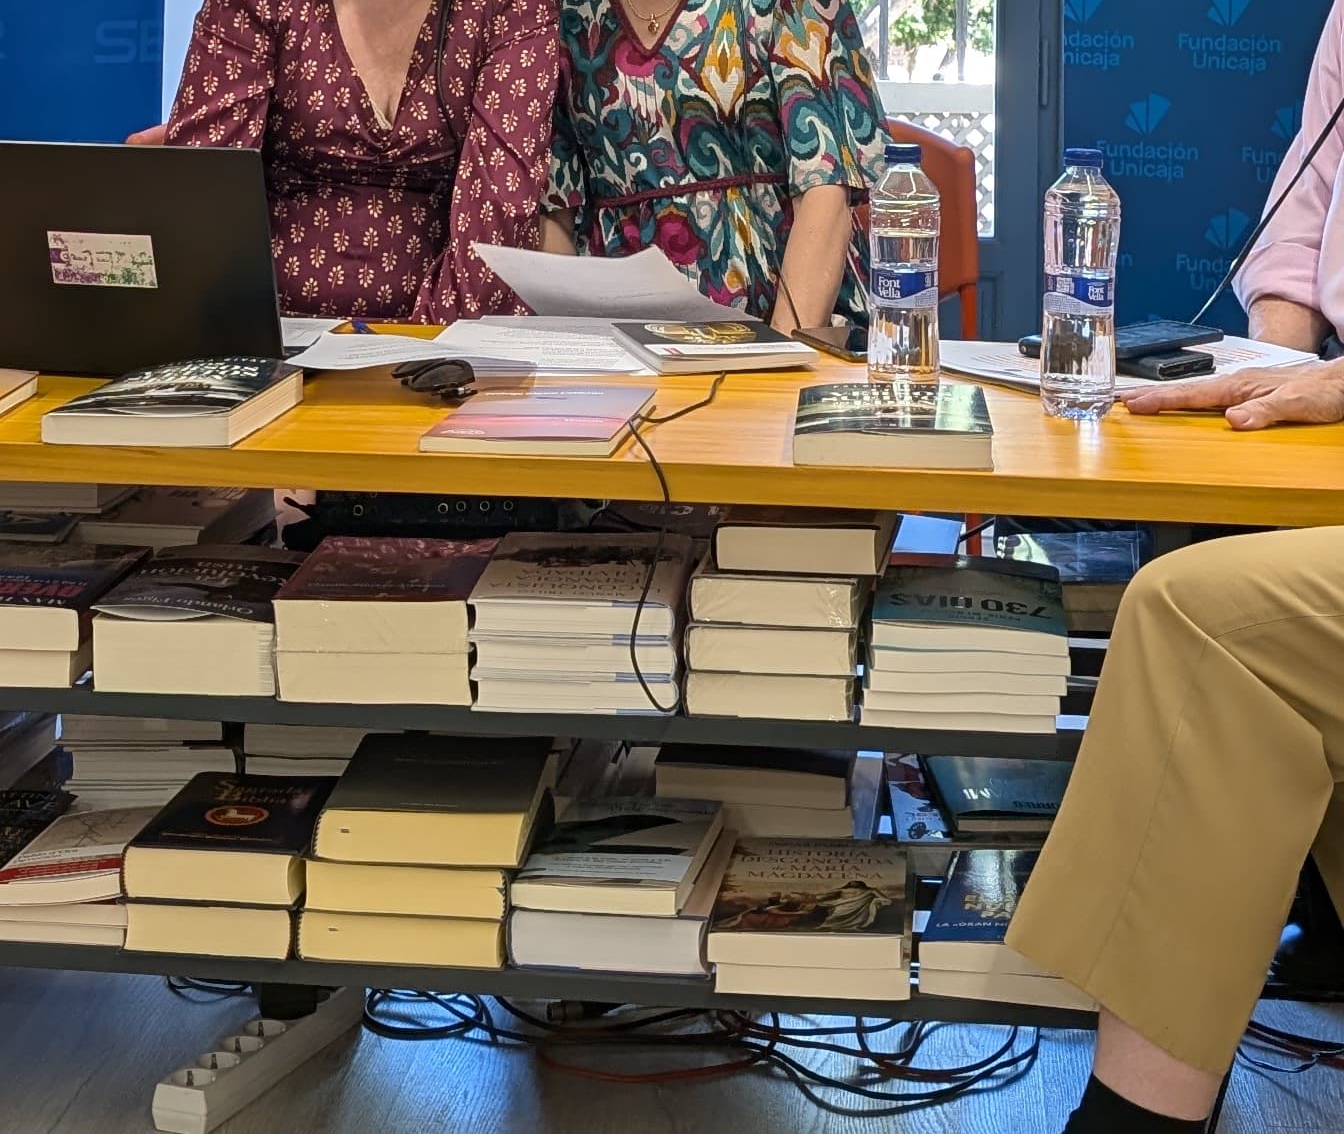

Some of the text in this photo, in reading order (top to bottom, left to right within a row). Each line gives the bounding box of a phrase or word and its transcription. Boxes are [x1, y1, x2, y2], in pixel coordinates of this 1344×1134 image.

[1178, 33, 1281, 53] Fundación
[1192, 52, 1267, 74] Unicaja
[1096, 140, 1199, 161] Fundación
[1110, 160, 1184, 183] Unicaja
[877, 276, 901, 288] Font
[878, 286, 903, 299] Vella
[1087, 285, 1104, 294] Font
[1087, 293, 1104, 301] Vella
[980, 597, 1054, 620] 730
[767, 848, 870, 858] HISTORIA
[741, 856, 894, 867] DESCONOCIDA
[745, 871, 884, 880] MAGDALENA
